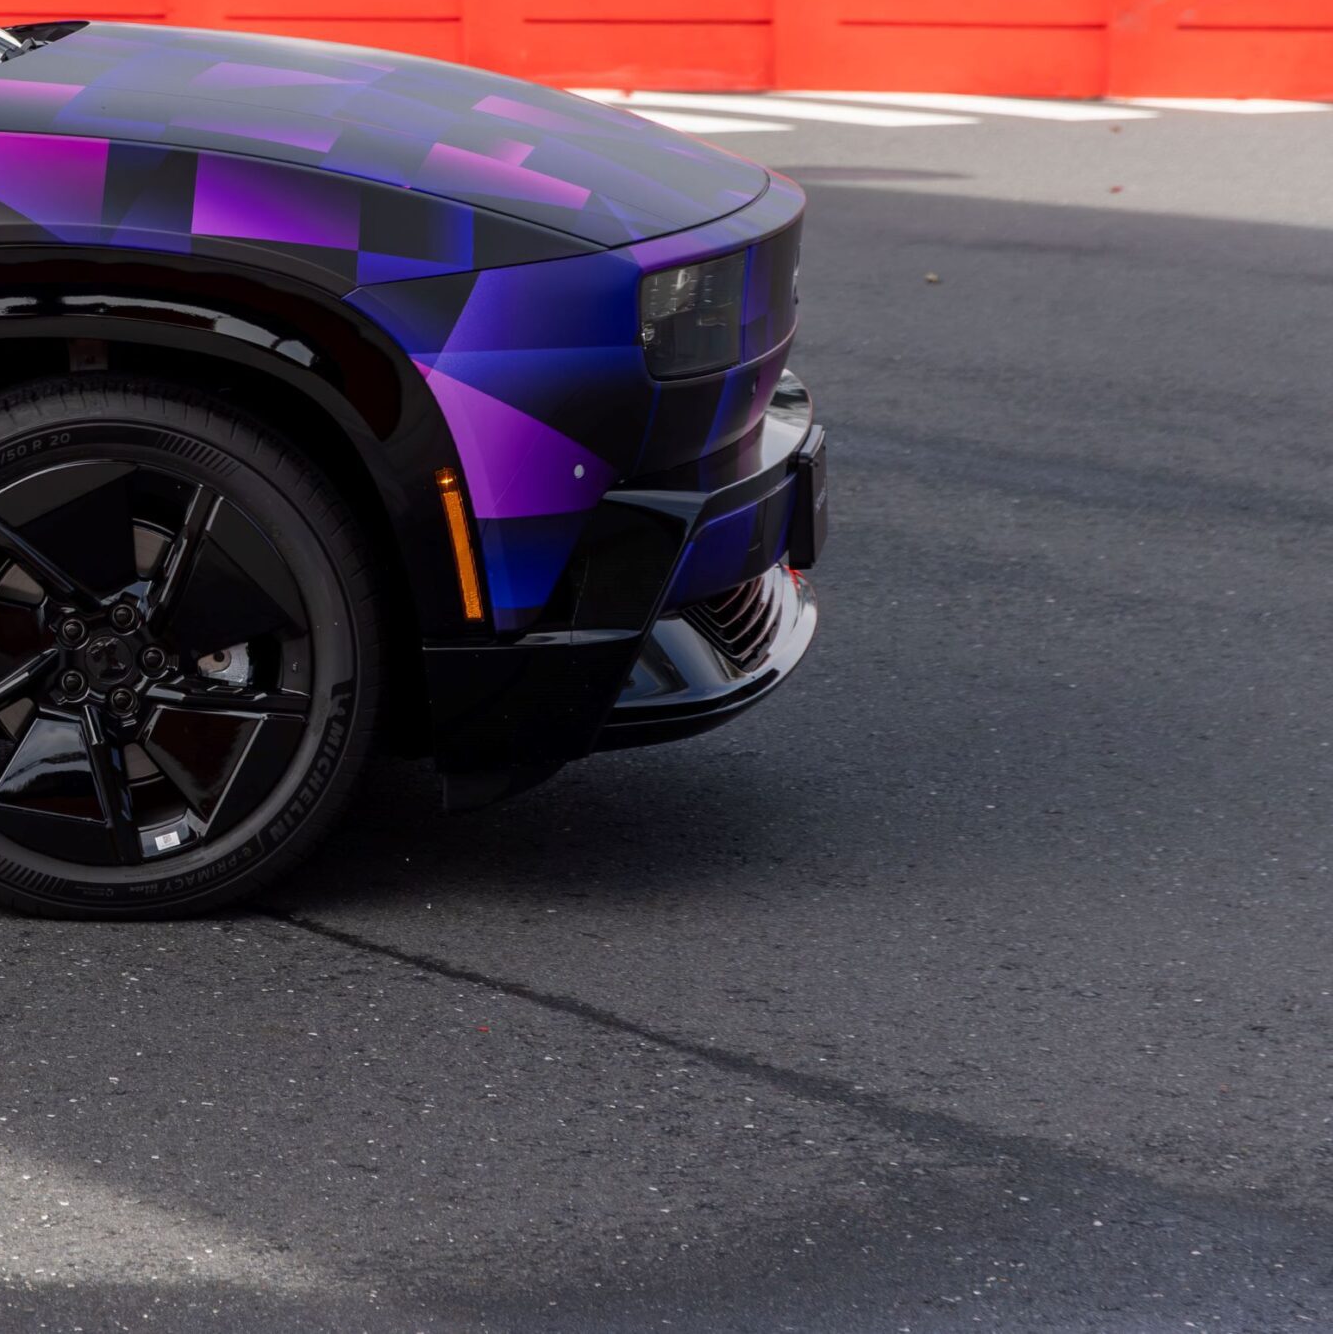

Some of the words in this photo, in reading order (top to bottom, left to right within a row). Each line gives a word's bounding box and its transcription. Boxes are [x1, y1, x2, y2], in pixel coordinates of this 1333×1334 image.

[33, 440, 43, 451] R
[50, 432, 71, 445] 20
[269, 722, 345, 841] MICHELIN
